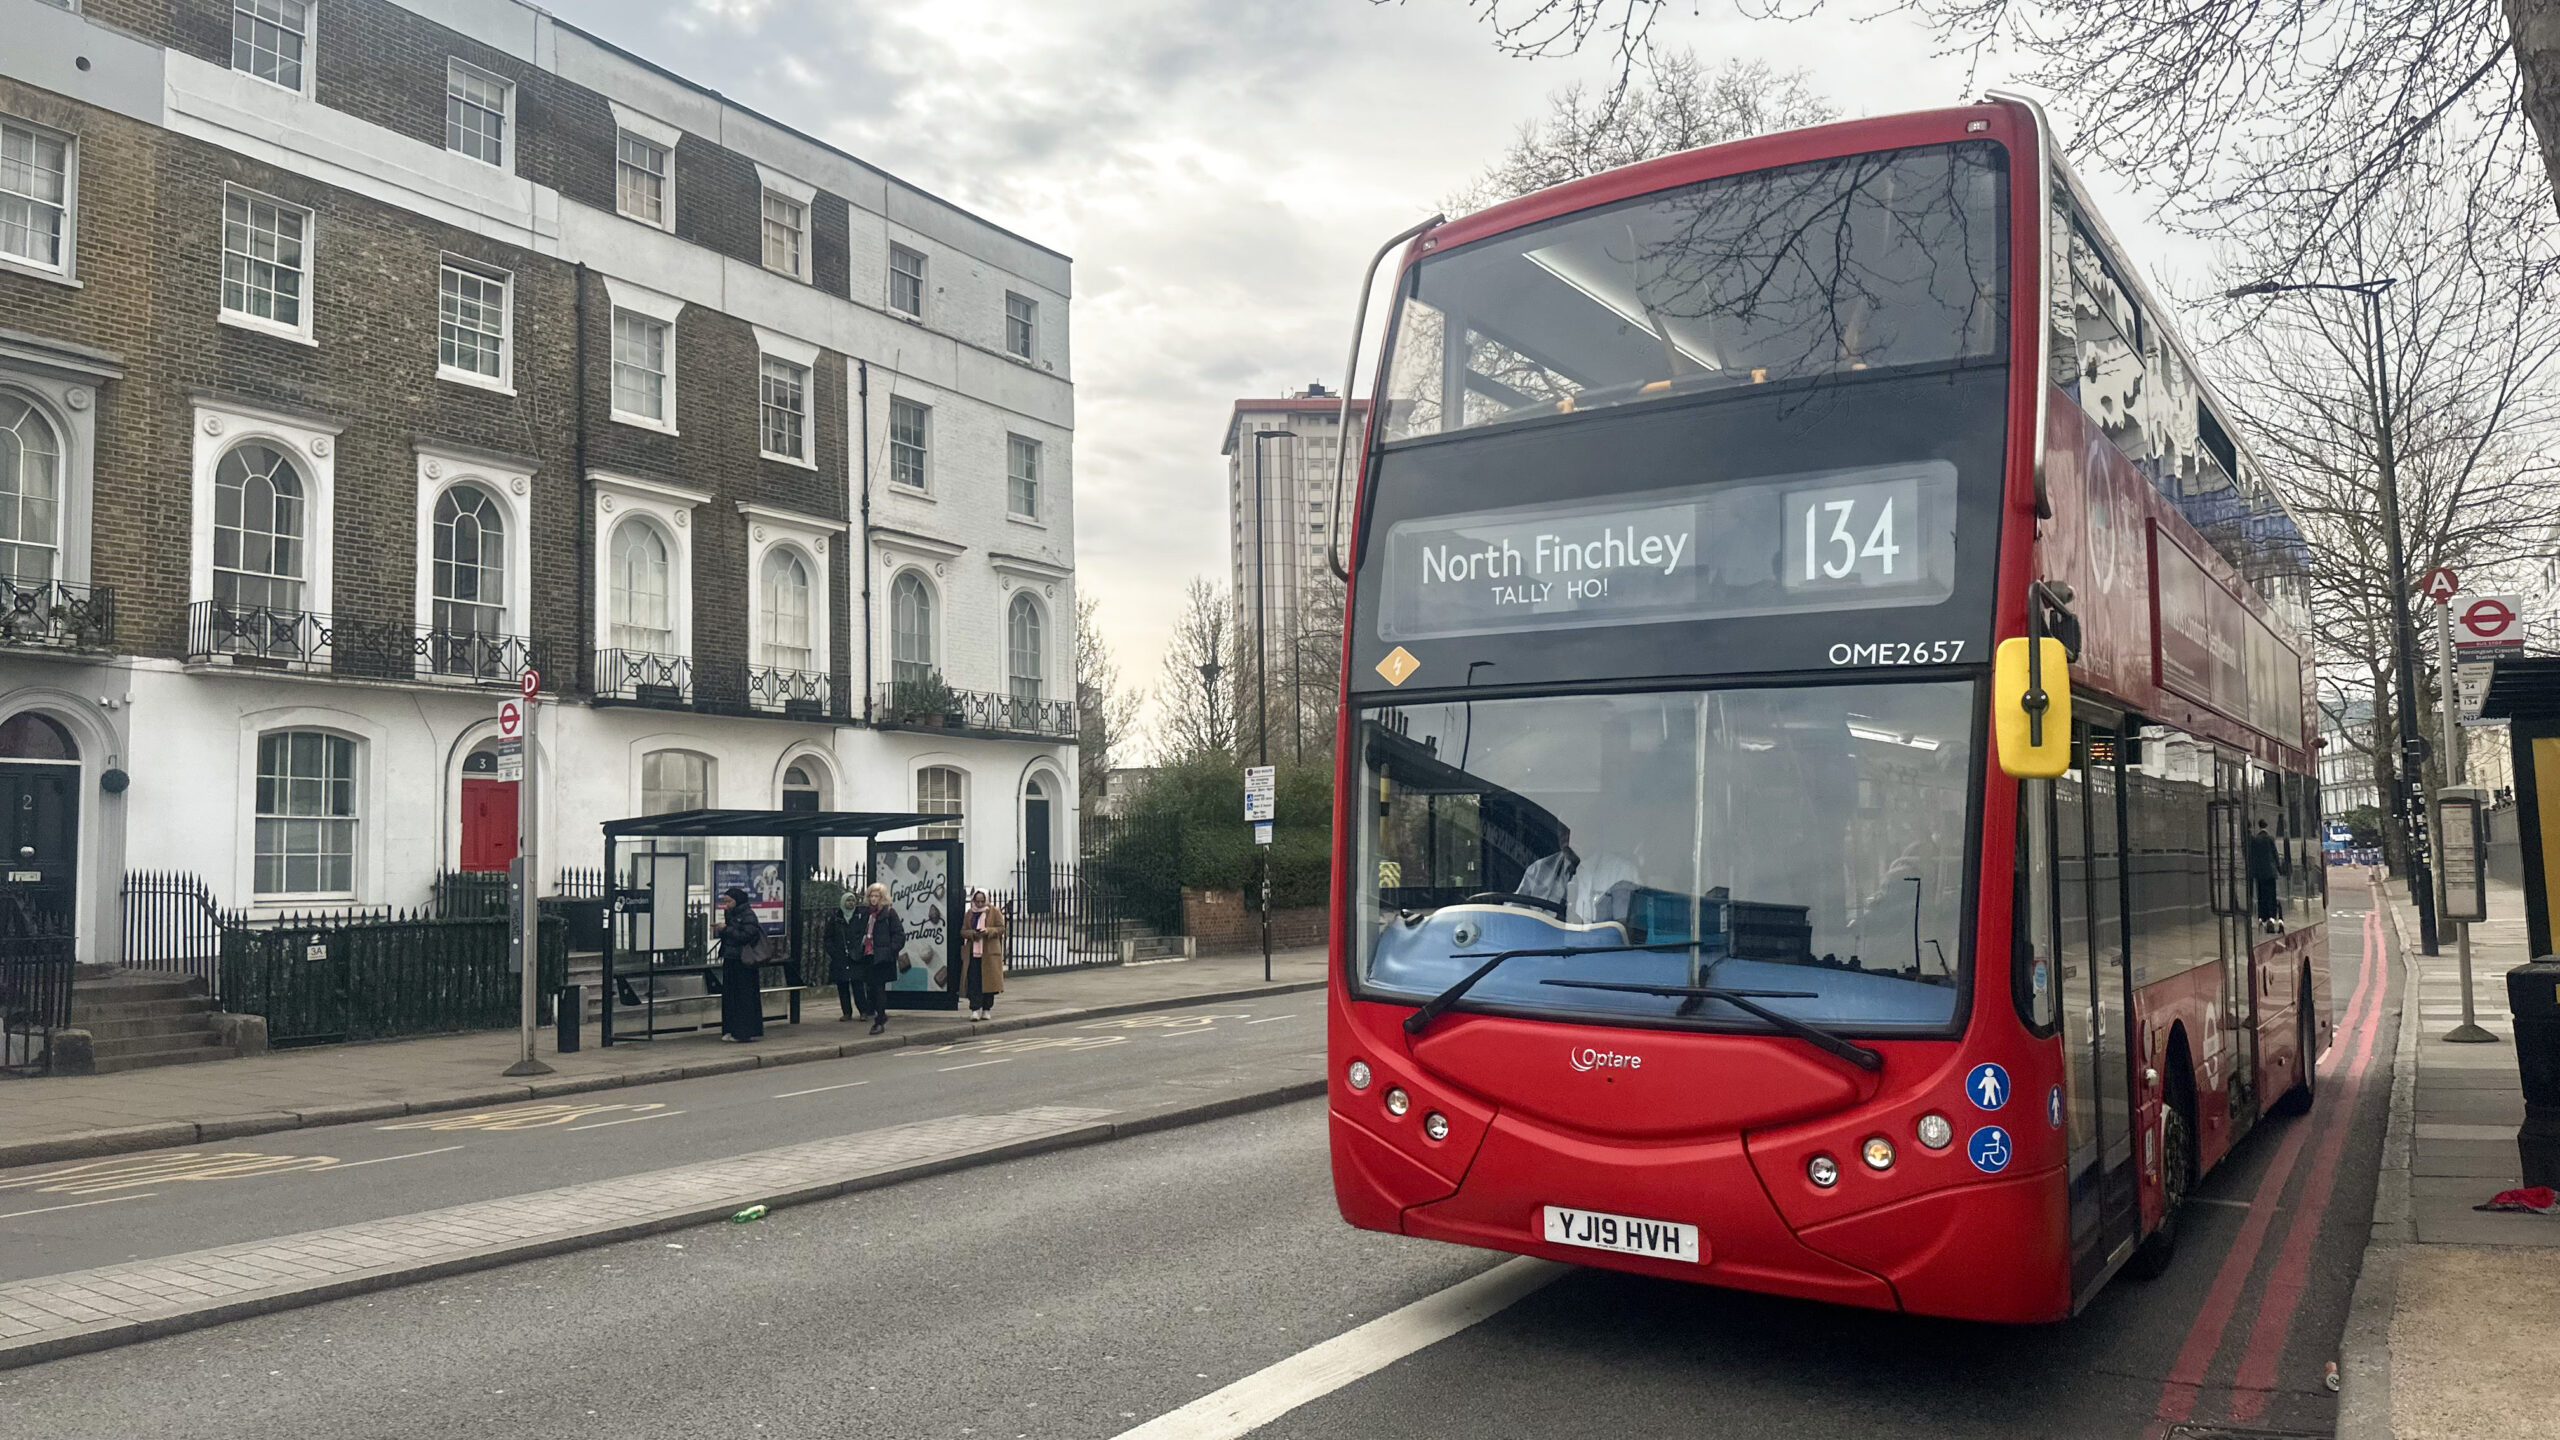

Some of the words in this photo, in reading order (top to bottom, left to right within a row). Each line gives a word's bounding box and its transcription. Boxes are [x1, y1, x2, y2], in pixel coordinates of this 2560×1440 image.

[1804, 495, 1901, 581] 134
[1422, 535, 1523, 584] North
[1535, 525, 1689, 576] Finchley
[1491, 581, 1553, 605] TALLY
[1567, 577, 1609, 600] HO!
[2430, 572, 2452, 594] A
[1828, 640, 1966, 665] OME2657
[2459, 648, 2493, 656] Mornington
[525, 673, 536, 693] D
[480, 758, 487, 769] 3
[22, 794, 33, 810] 2
[625, 896, 649, 905] Camden
[310, 946, 323, 956] 3A
[1580, 1048, 1642, 1072] Optare
[1559, 1212, 1617, 1245] YJ19
[1626, 1221, 1680, 1254] HVH
